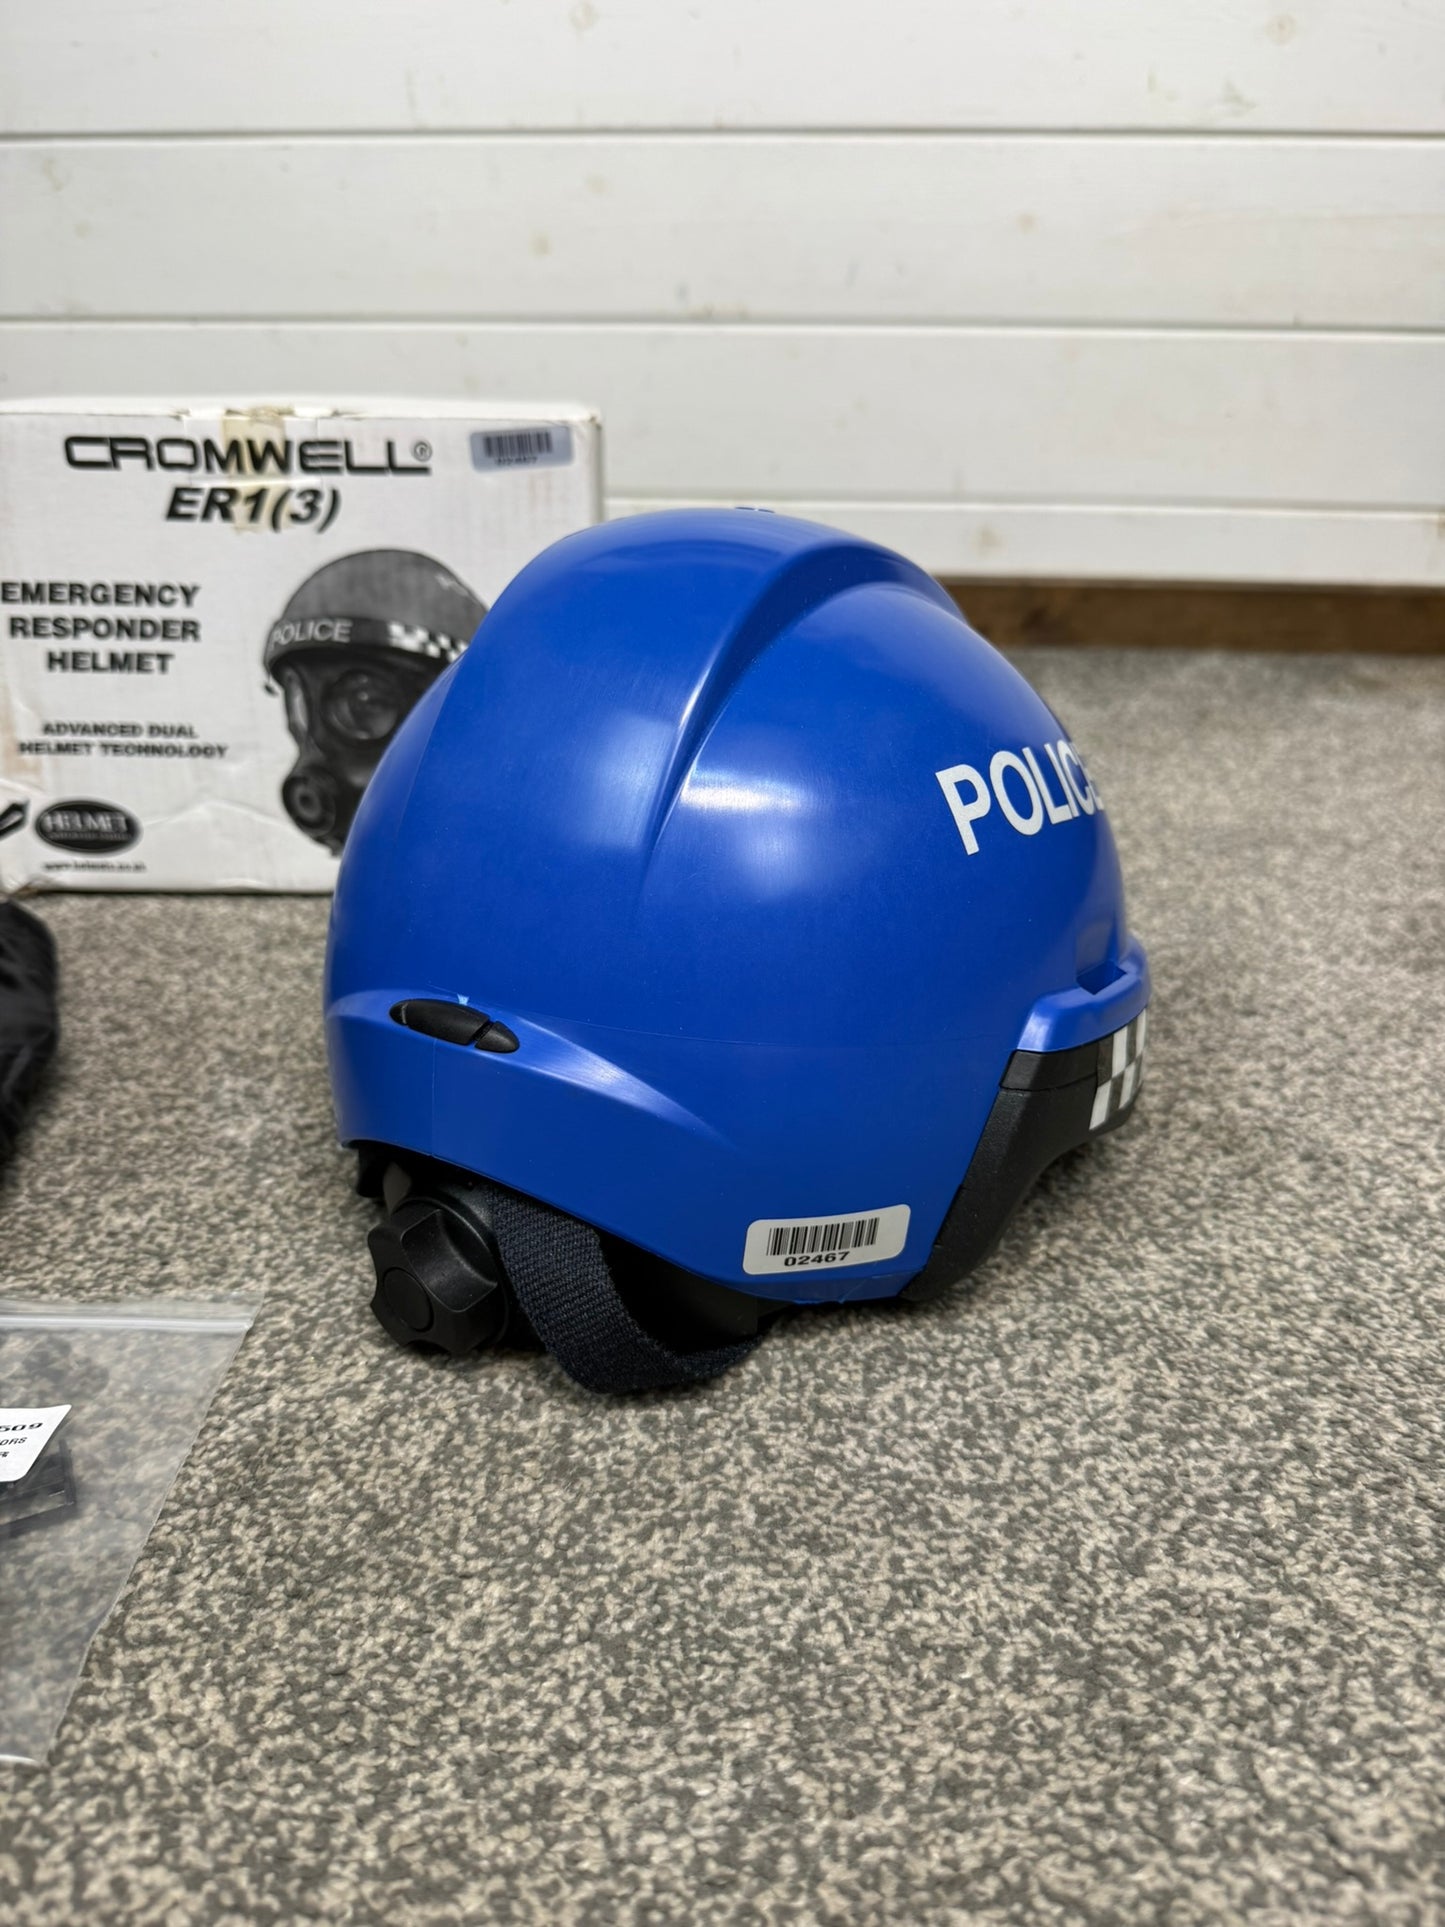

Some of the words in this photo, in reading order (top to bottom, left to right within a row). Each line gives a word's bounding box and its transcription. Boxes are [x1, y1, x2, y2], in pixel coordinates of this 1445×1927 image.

[165, 485, 341, 533] ER1(3)
[1, 582, 200, 607] EMERGENCY
[9, 616, 201, 642] RESPONDER
[269, 619, 353, 652] POLICE
[47, 651, 175, 674] HELMET
[43, 722, 144, 737] ADVANCED
[149, 724, 199, 738] DUAL
[20, 742, 92, 755] HELMET
[101, 743, 228, 758] TECHNOLOGY
[935, 739, 1104, 855] POLIC
[784, 1251, 850, 1267] 02467
